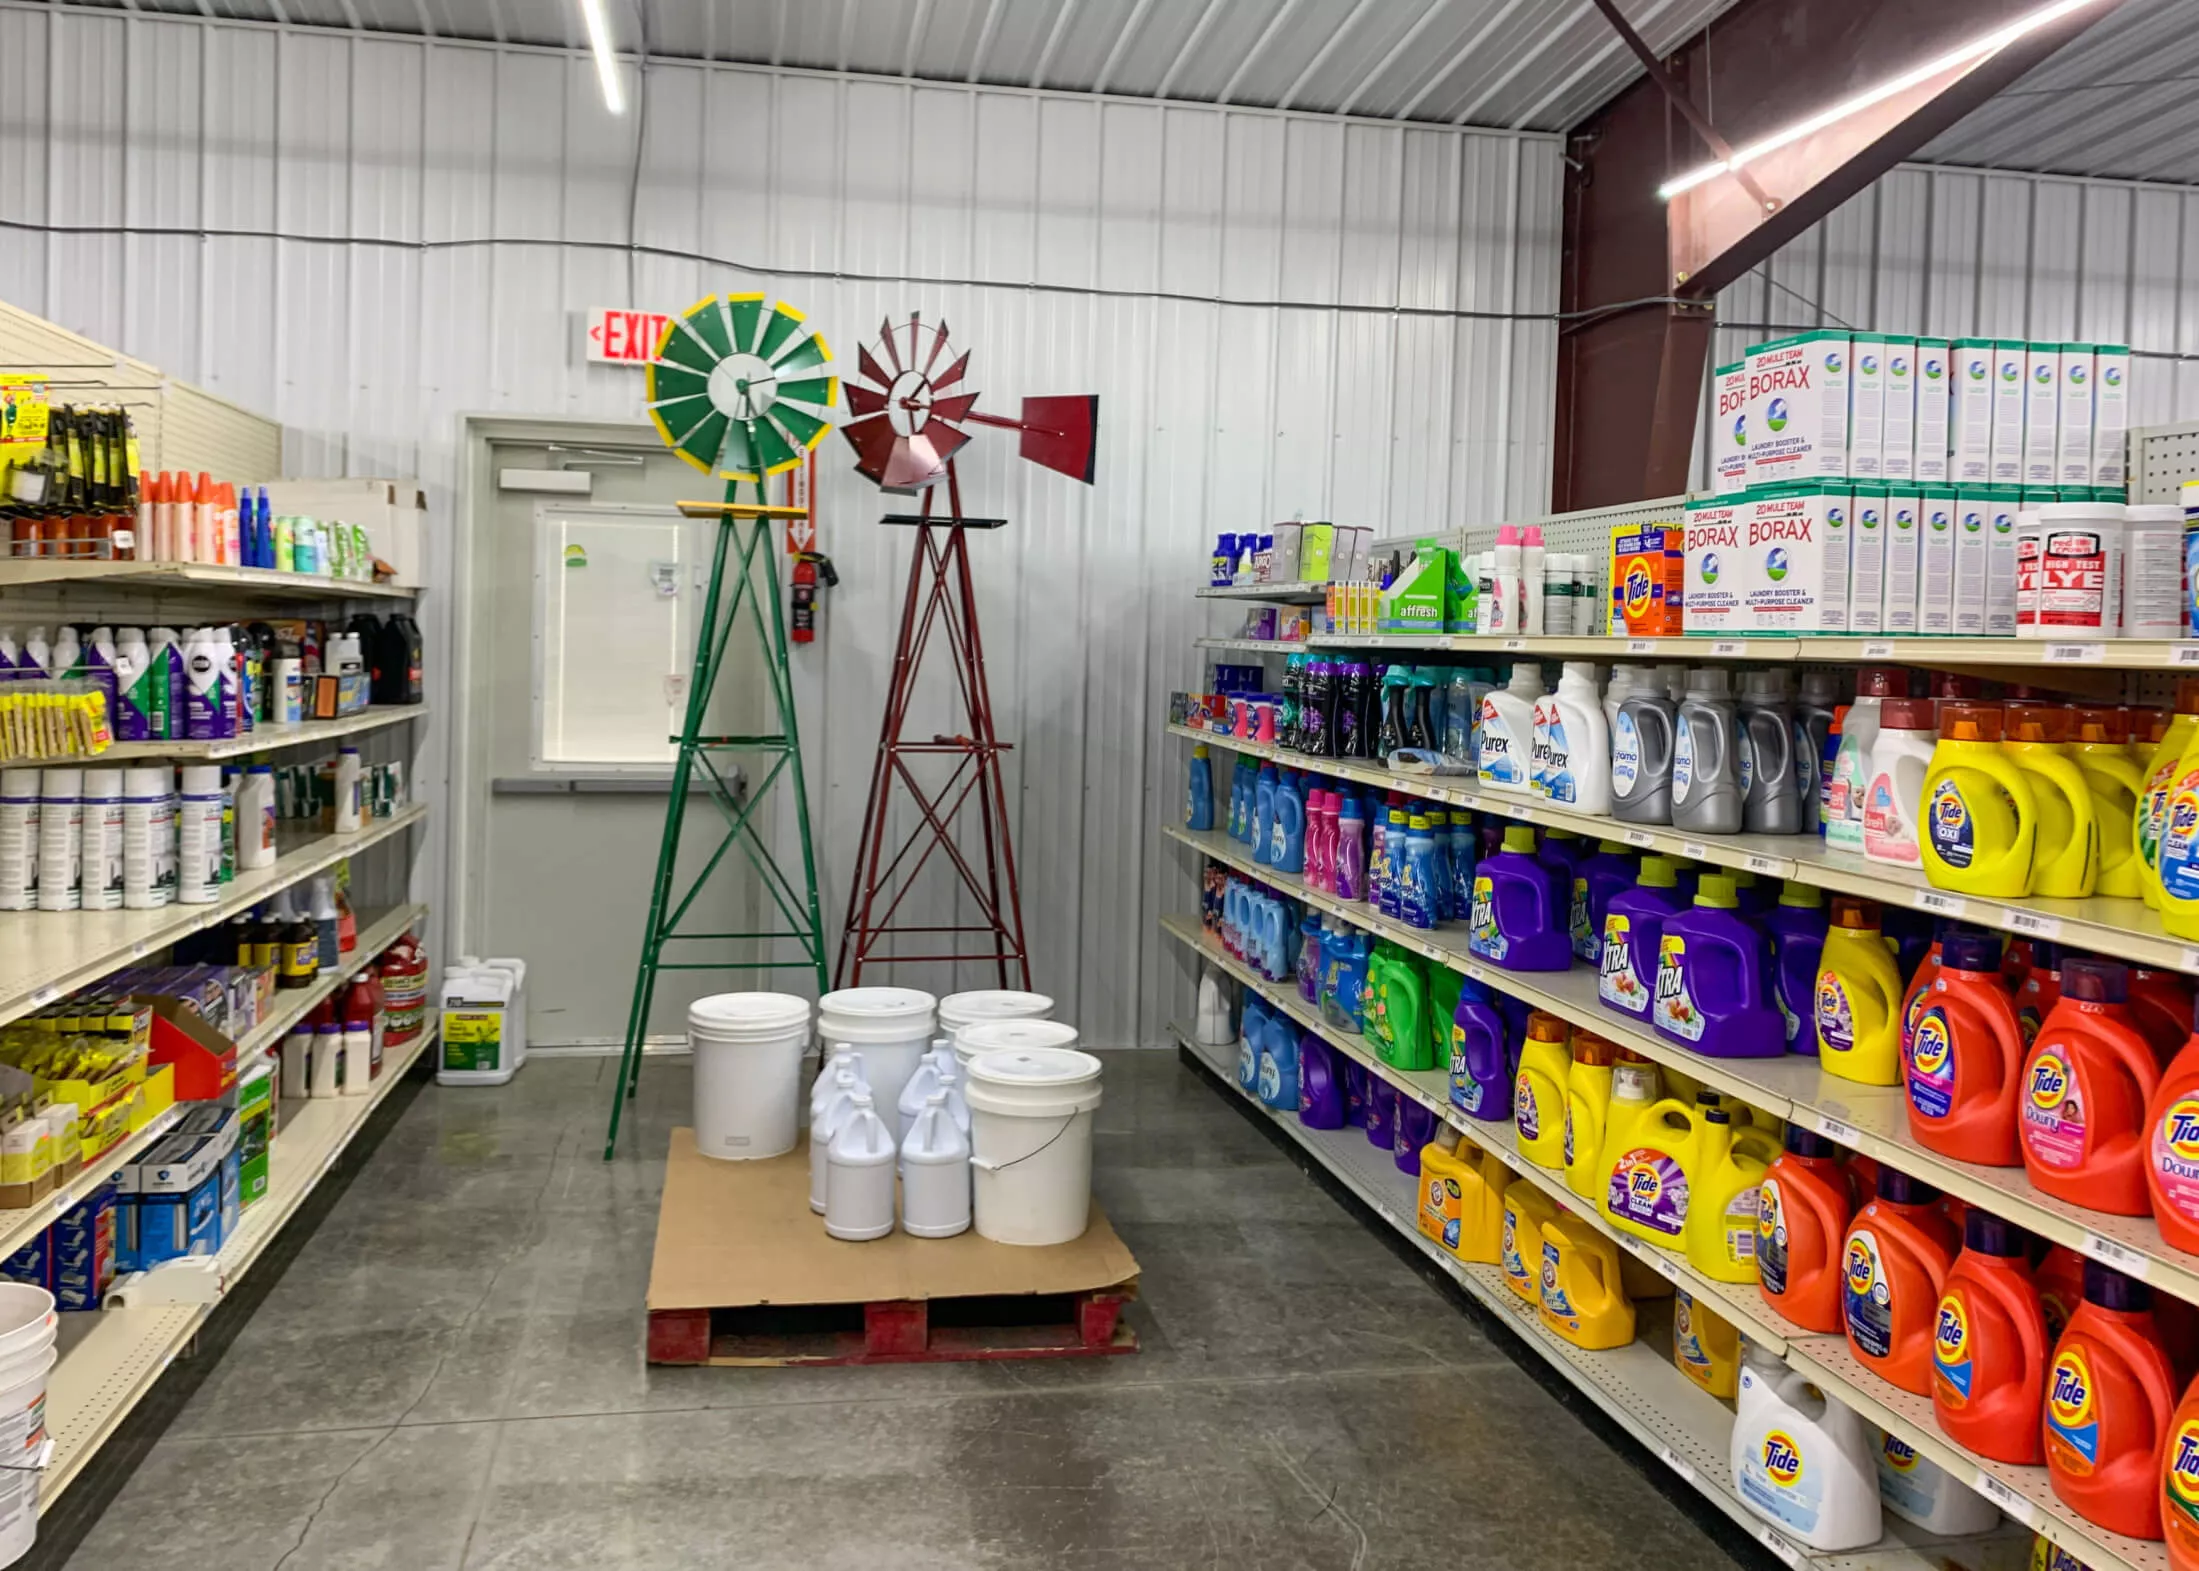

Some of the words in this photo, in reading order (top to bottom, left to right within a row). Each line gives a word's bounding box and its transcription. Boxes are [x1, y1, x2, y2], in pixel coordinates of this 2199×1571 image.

[603, 311, 668, 361] EXIT
[1765, 351, 1785, 364] MULE
[1785, 348, 1804, 360] TEAM
[1750, 365, 1810, 400] BORAX
[1752, 441, 1774, 451] LAUNDRY
[1775, 437, 1800, 447] BOOSTER
[1786, 444, 1812, 455] CLEANER
[1702, 510, 1717, 520] MULE
[1718, 509, 1733, 518] TEAM
[1767, 502, 1787, 513] MULE
[1787, 500, 1804, 510] TEAM
[1688, 526, 1738, 552] BORAX
[1749, 518, 1812, 546] BORAX
[2045, 560, 2069, 570] HIGH
[2076, 560, 2101, 570] TEST
[1627, 572, 1649, 606] Tide
[2043, 570, 2104, 588] LYE
[1400, 604, 1437, 618] affresh
[1718, 599, 1739, 607] CLEANER
[1786, 597, 1814, 605] CLEANER
[1481, 730, 1509, 753] Purex
[1532, 737, 1549, 760] Pure
[1940, 803, 1961, 820] Tide
[2171, 804, 2198, 829] Tide
[1940, 827, 1957, 839] OXI
[2168, 839, 2188, 850] CLEAN
[1471, 900, 1491, 932] XTRA
[1570, 900, 1586, 932] XTRA
[1600, 940, 1629, 977] XTRA
[1656, 963, 1683, 1003] XTRA
[1821, 992, 1837, 1009] Tide
[1917, 1028, 1944, 1057] Tide
[2031, 1068, 2063, 1093] Tide
[2027, 1106, 2060, 1133] Downy
[2170, 1114, 2199, 1144] Tid
[2163, 1157, 2199, 1180] Down
[1632, 1172, 1658, 1192] Tide
[1631, 1197, 1652, 1209] CLEAN
[1761, 1199, 1774, 1224] Tide
[1849, 1252, 1870, 1280] Tide
[1936, 1310, 1963, 1346] Tide
[2052, 1367, 2086, 1406] Tide
[1765, 1440, 1799, 1473] Tide
[2174, 1435, 2199, 1477] Tid
